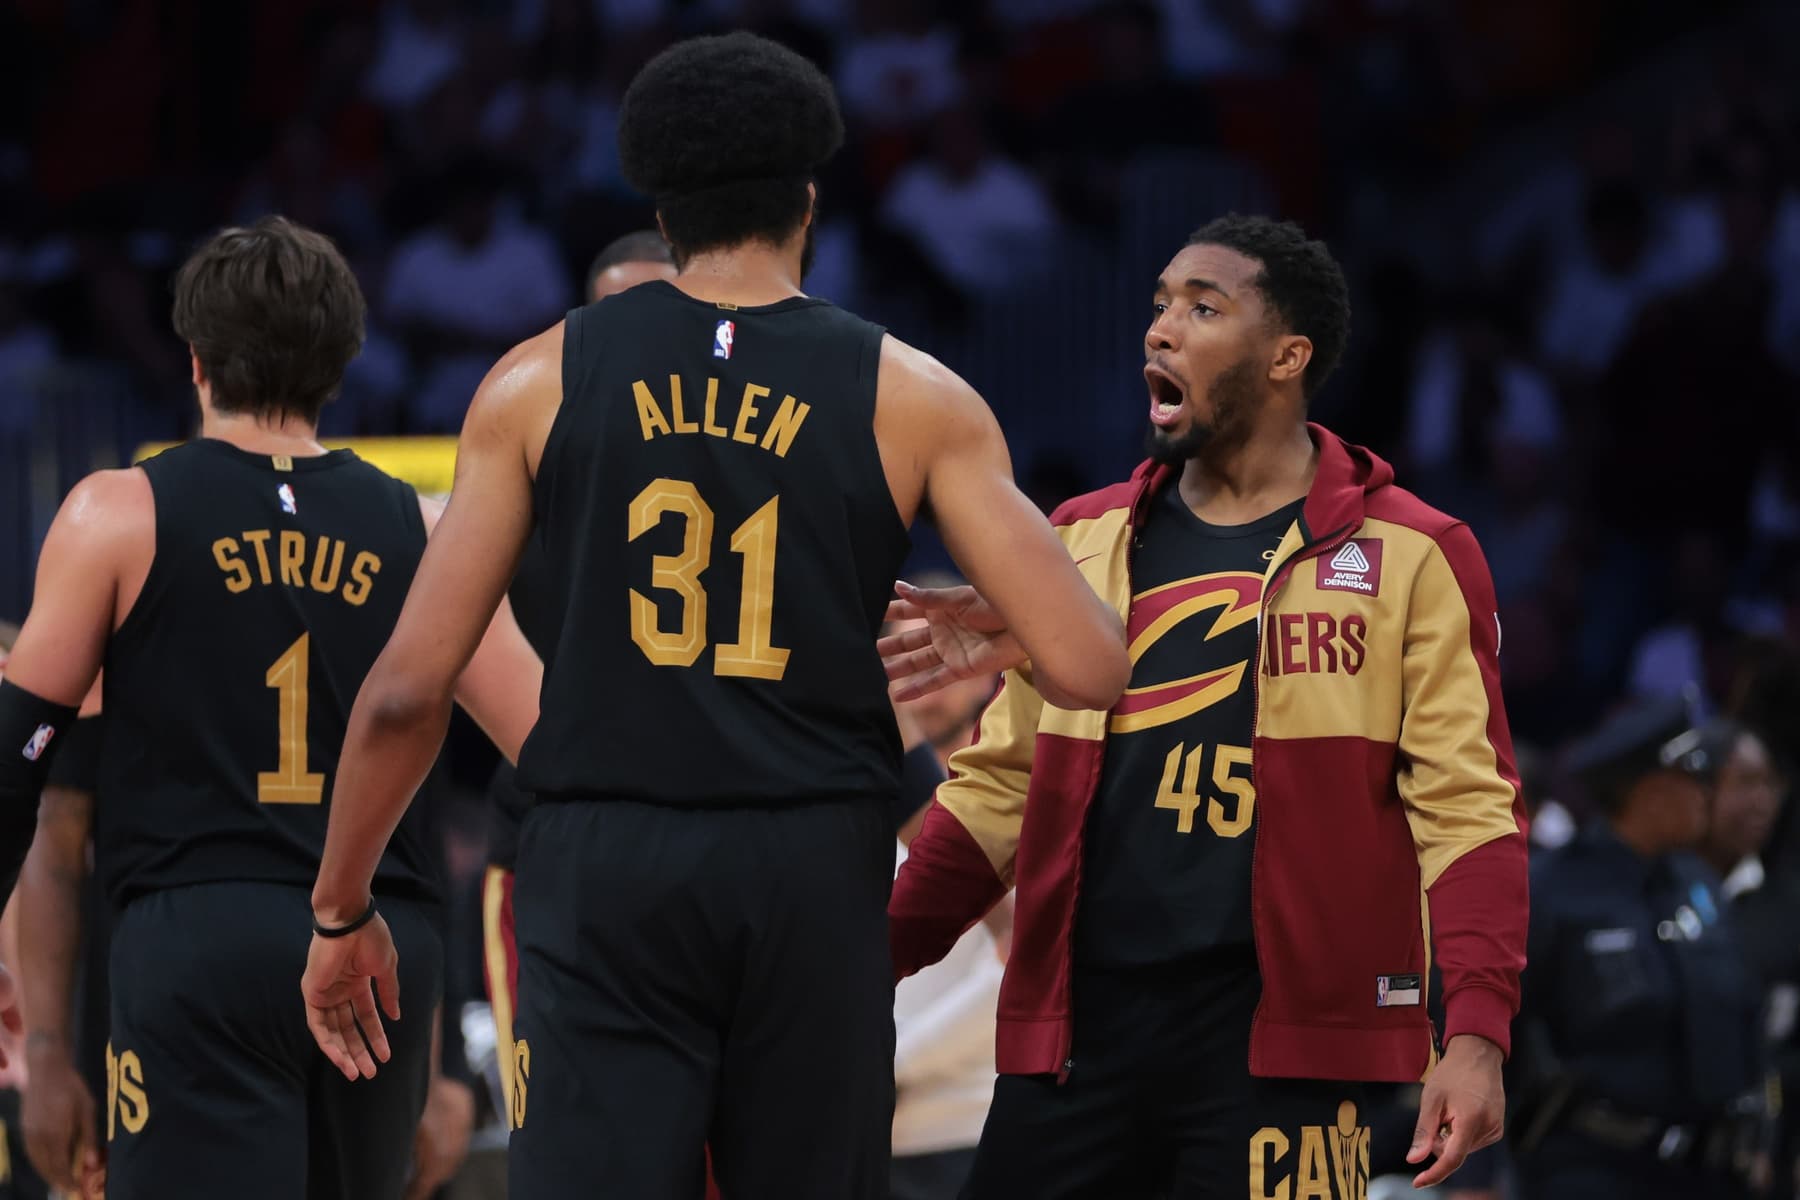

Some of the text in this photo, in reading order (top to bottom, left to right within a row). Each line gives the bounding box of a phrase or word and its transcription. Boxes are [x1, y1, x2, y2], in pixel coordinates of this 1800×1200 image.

[632, 374, 811, 458] ALLEN
[212, 529, 382, 606] STRUS
[627, 477, 791, 681] 31
[1324, 578, 1373, 592] DENNISON
[1333, 572, 1364, 582] AVERY
[1262, 612, 1367, 677] IERS
[257, 631, 325, 804] 1
[1154, 741, 1256, 839] 45
